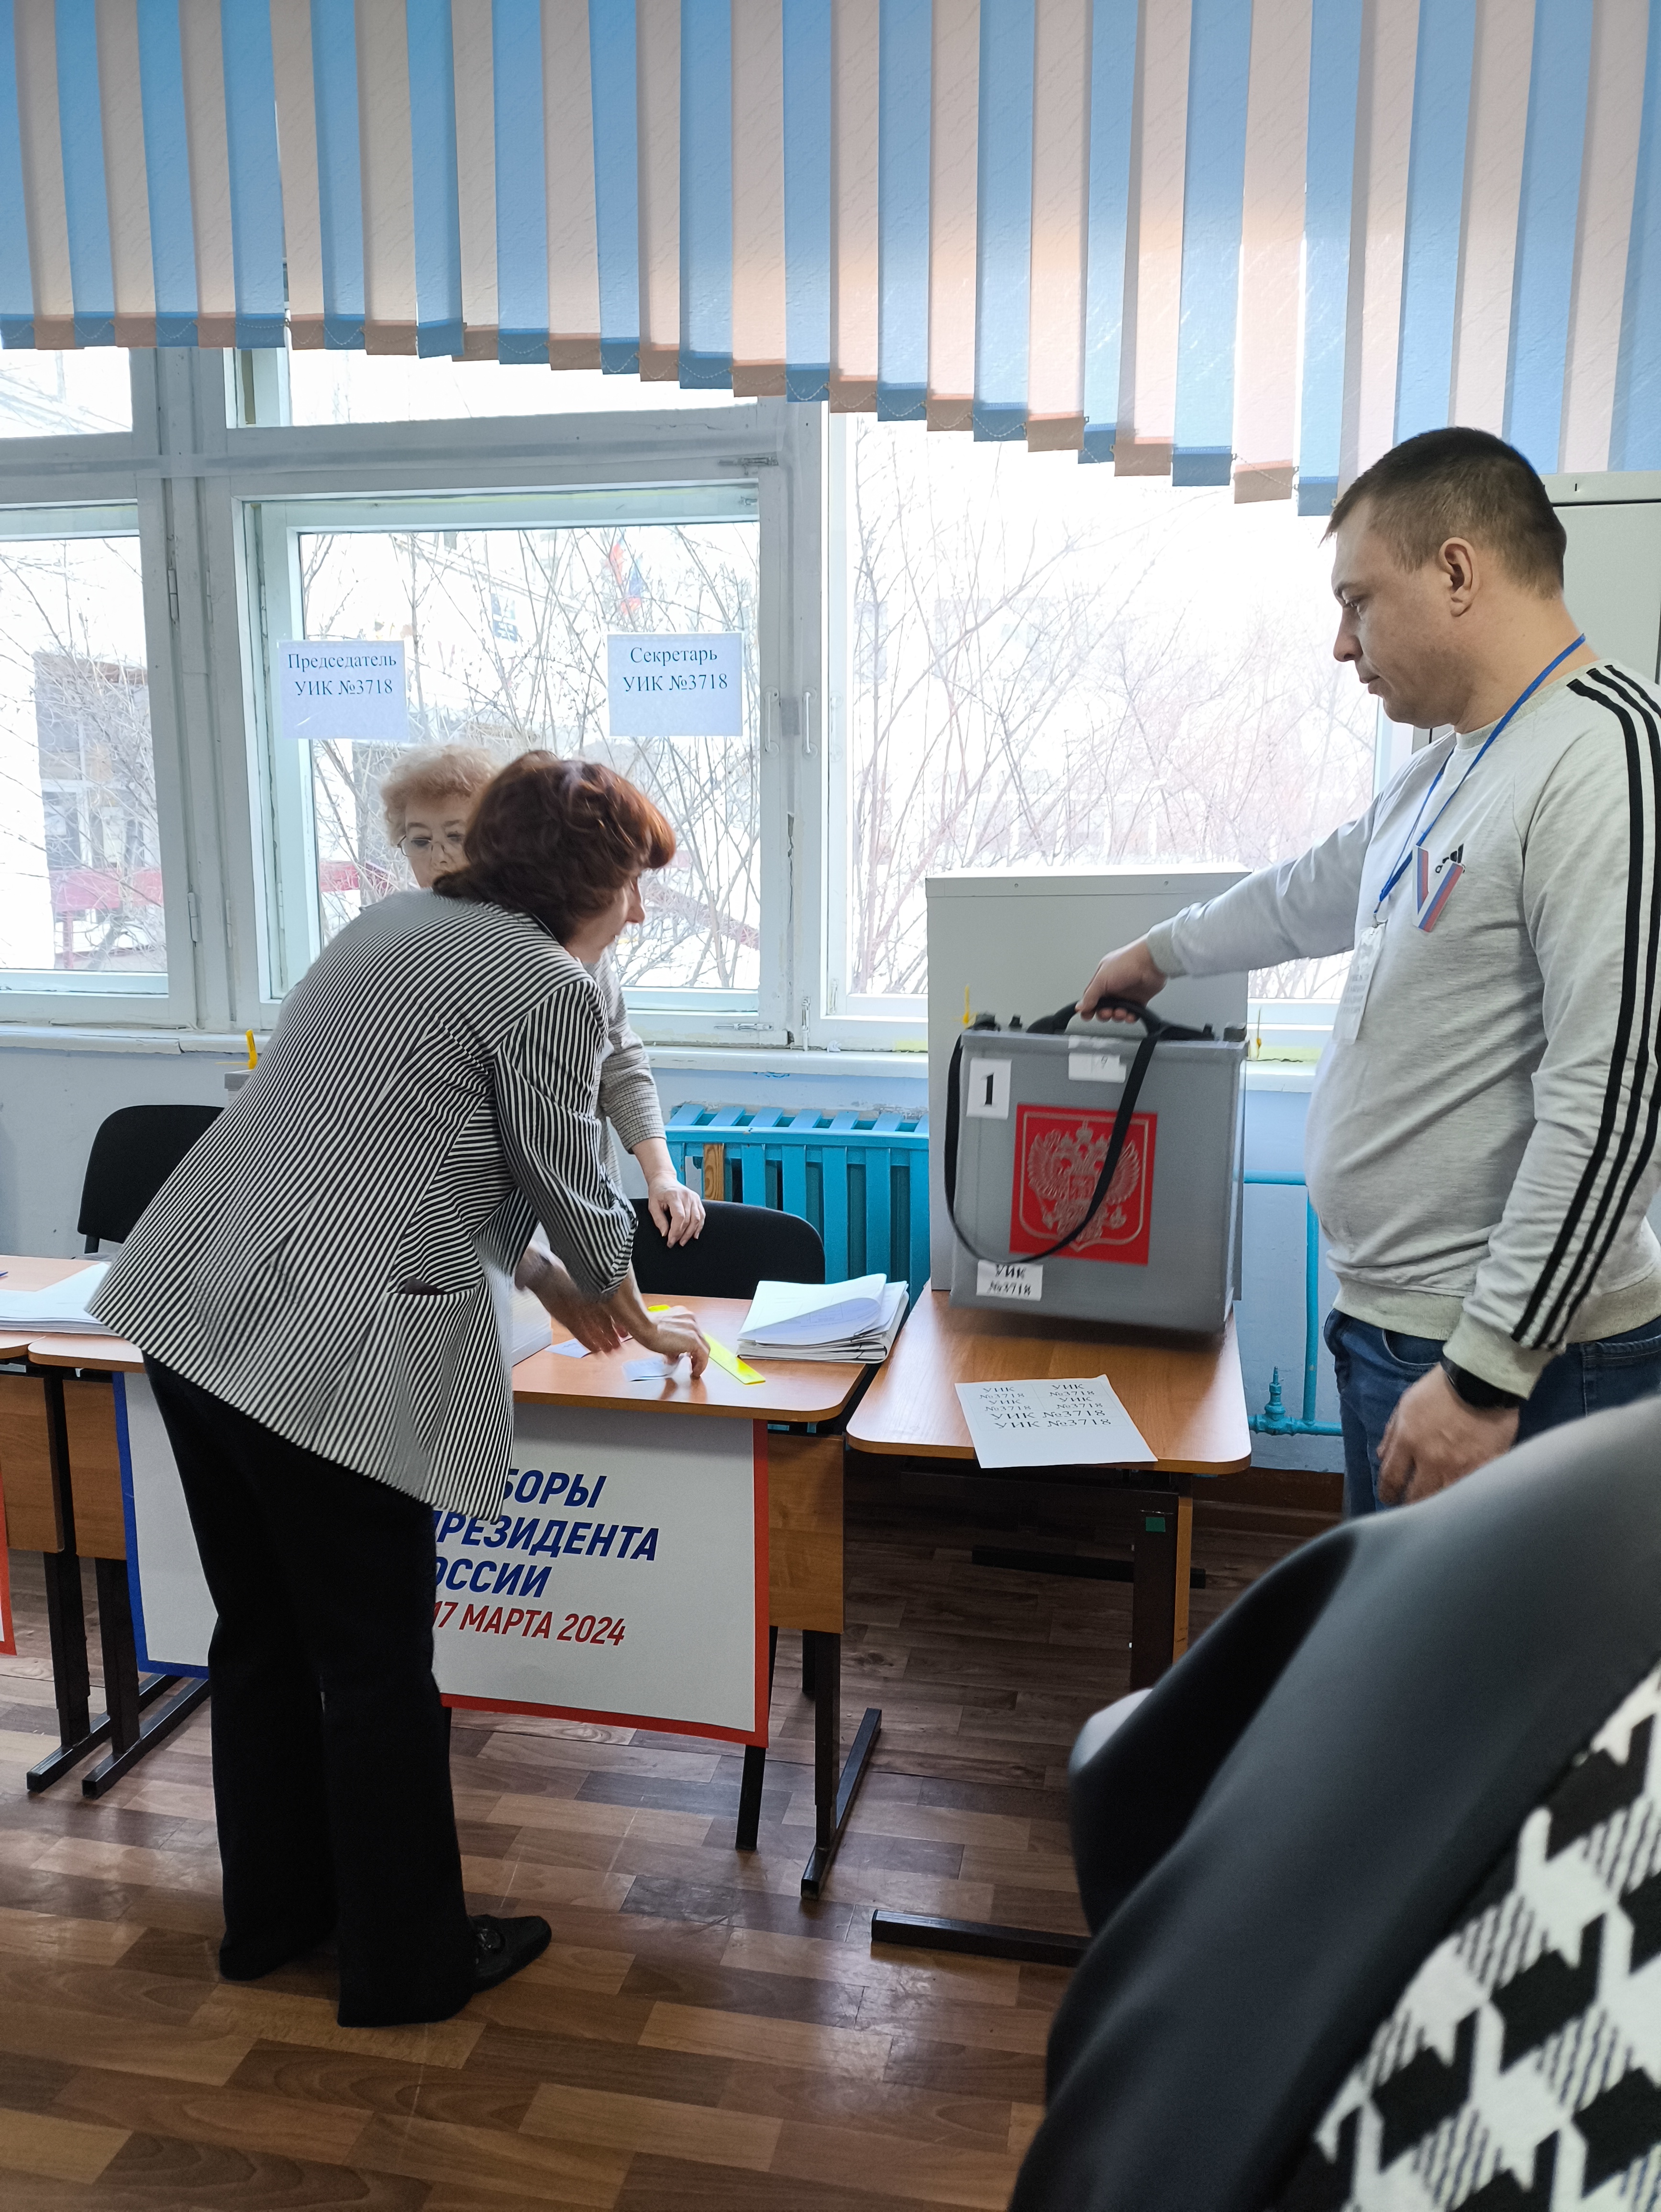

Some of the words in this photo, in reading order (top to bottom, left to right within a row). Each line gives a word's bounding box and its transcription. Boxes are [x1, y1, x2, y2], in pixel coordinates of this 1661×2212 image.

[288, 653, 397, 673] Председатель
[630, 647, 718, 666] Секретарь
[295, 680, 332, 696] УИК
[339, 679, 393, 695] №3718
[622, 675, 663, 692] УИК
[669, 674, 727, 690] №3718
[984, 1072, 995, 1106] 1
[995, 1264, 1027, 1279] УИК
[1042, 1410, 1106, 1418] №3718
[1047, 1419, 1111, 1427] №3718
[459, 1603, 554, 1639] МАРТА
[556, 1614, 625, 1646] 2024
